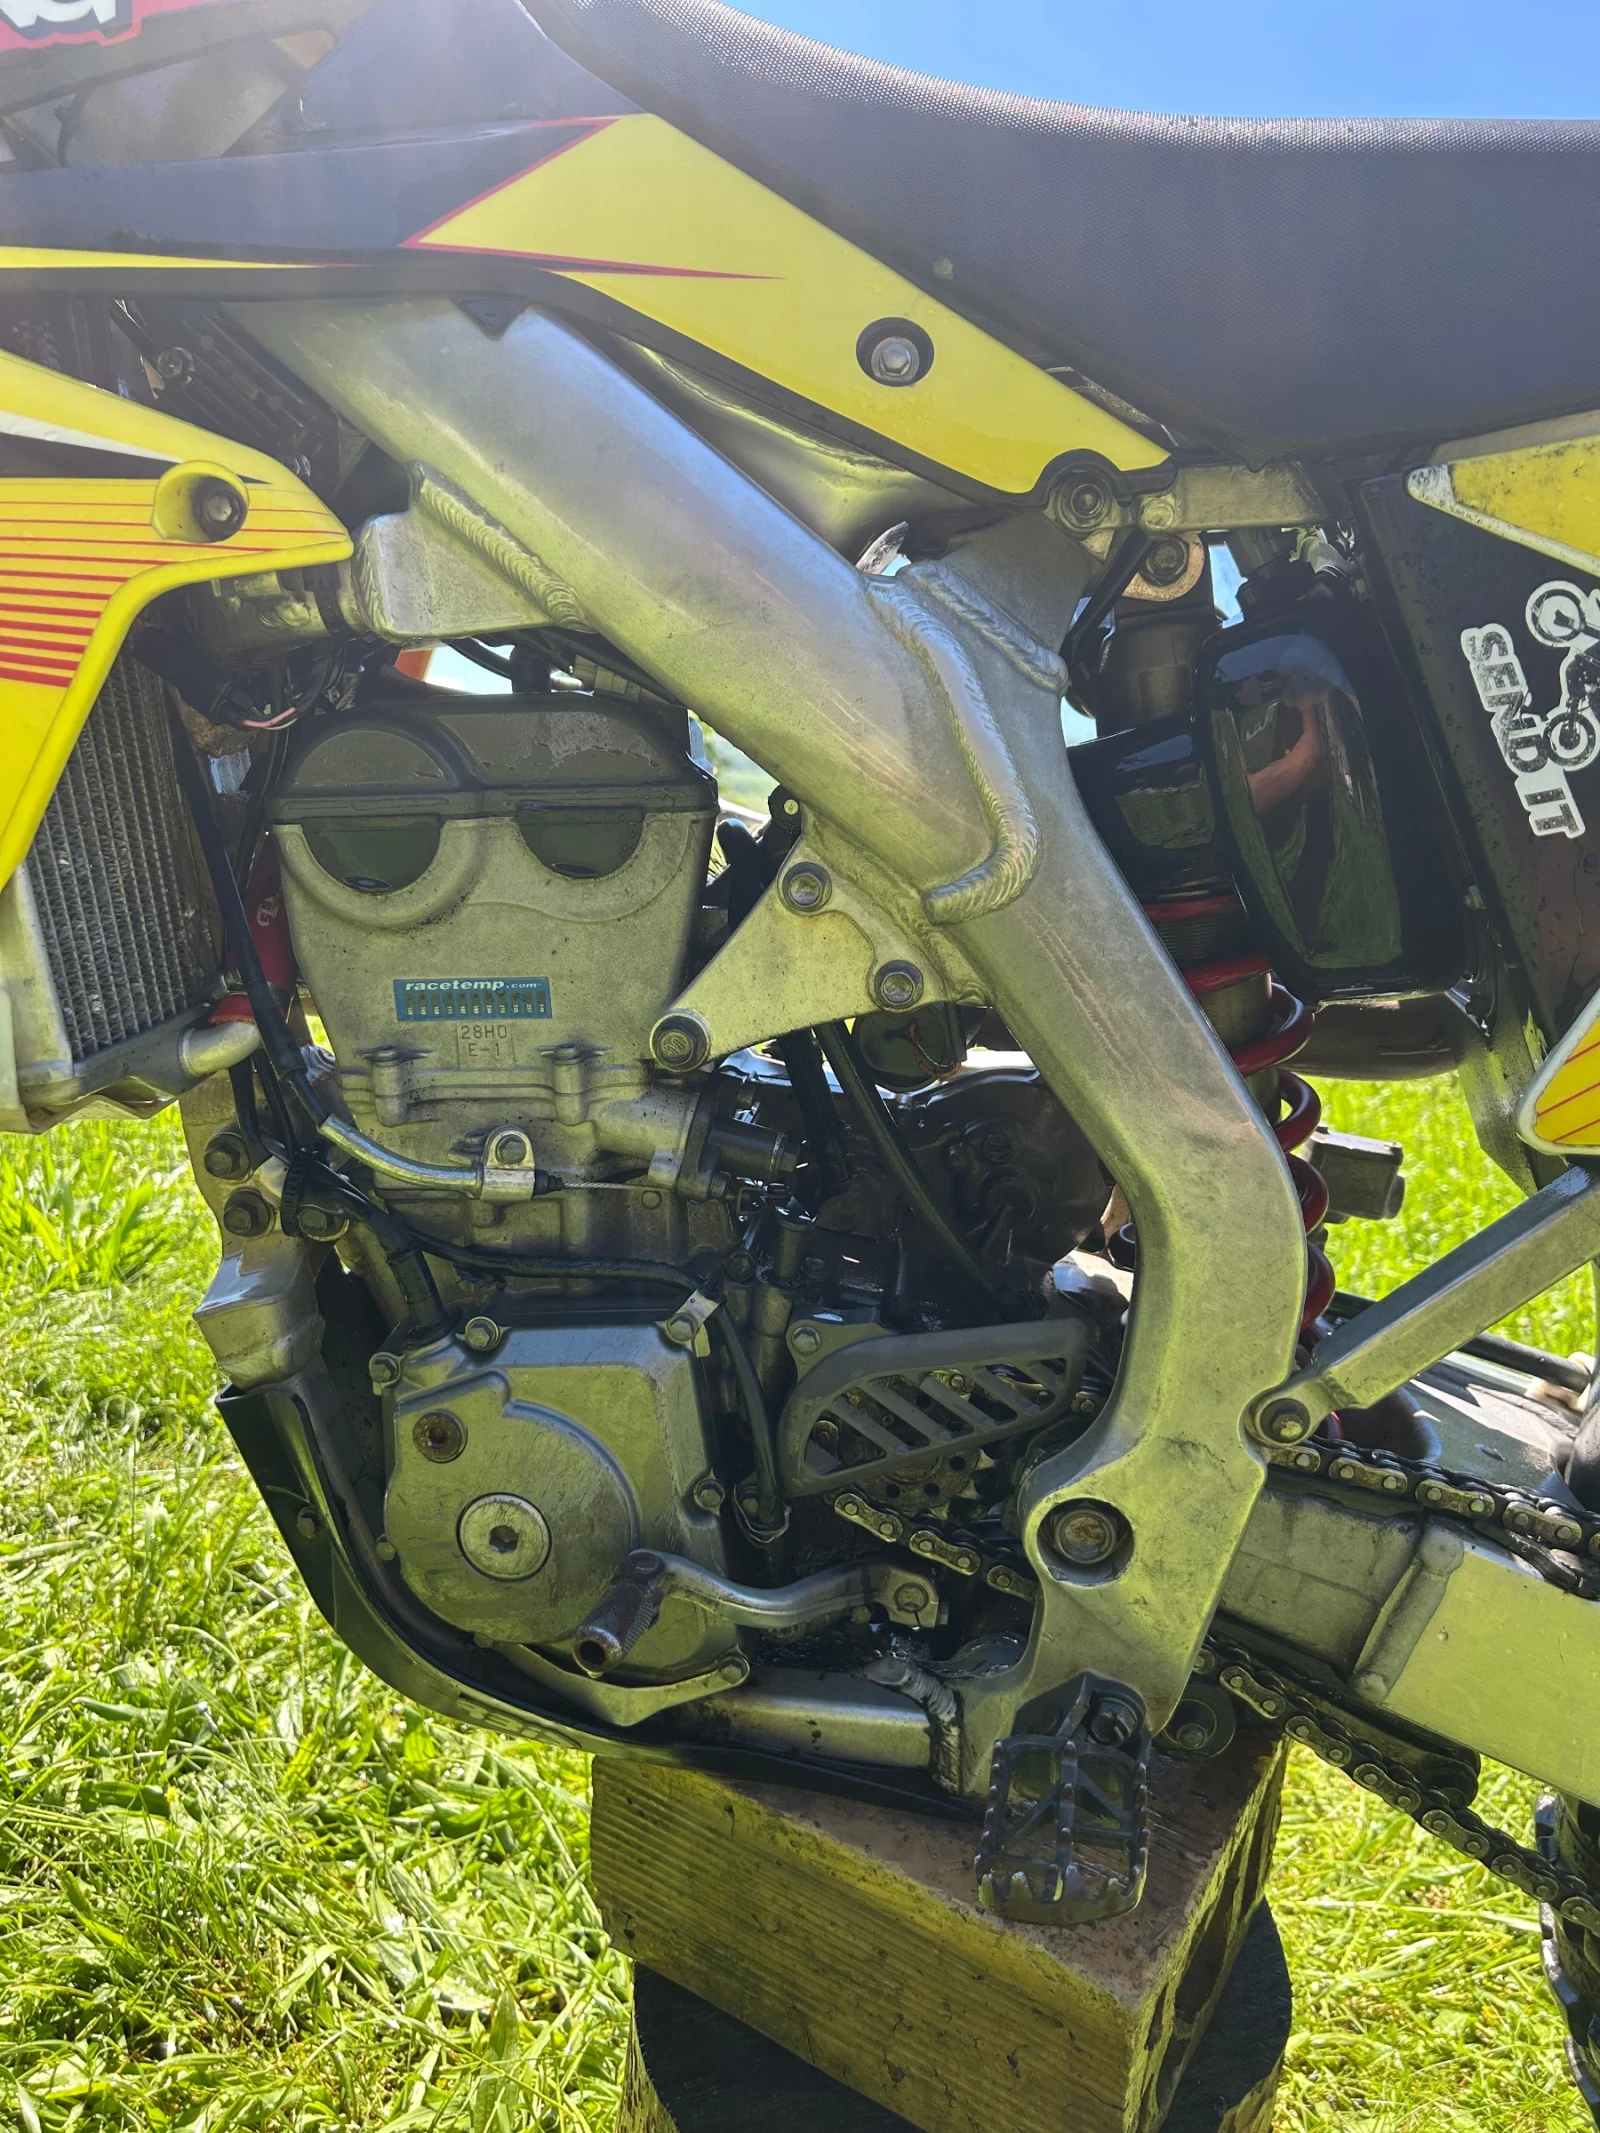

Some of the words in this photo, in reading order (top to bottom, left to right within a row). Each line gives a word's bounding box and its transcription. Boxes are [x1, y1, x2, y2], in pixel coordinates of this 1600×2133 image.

[1465, 631, 1549, 773] SEND
[1525, 787, 1579, 833] IT
[405, 980, 537, 991] racetemp.com
[468, 1043, 500, 1057] E-1
